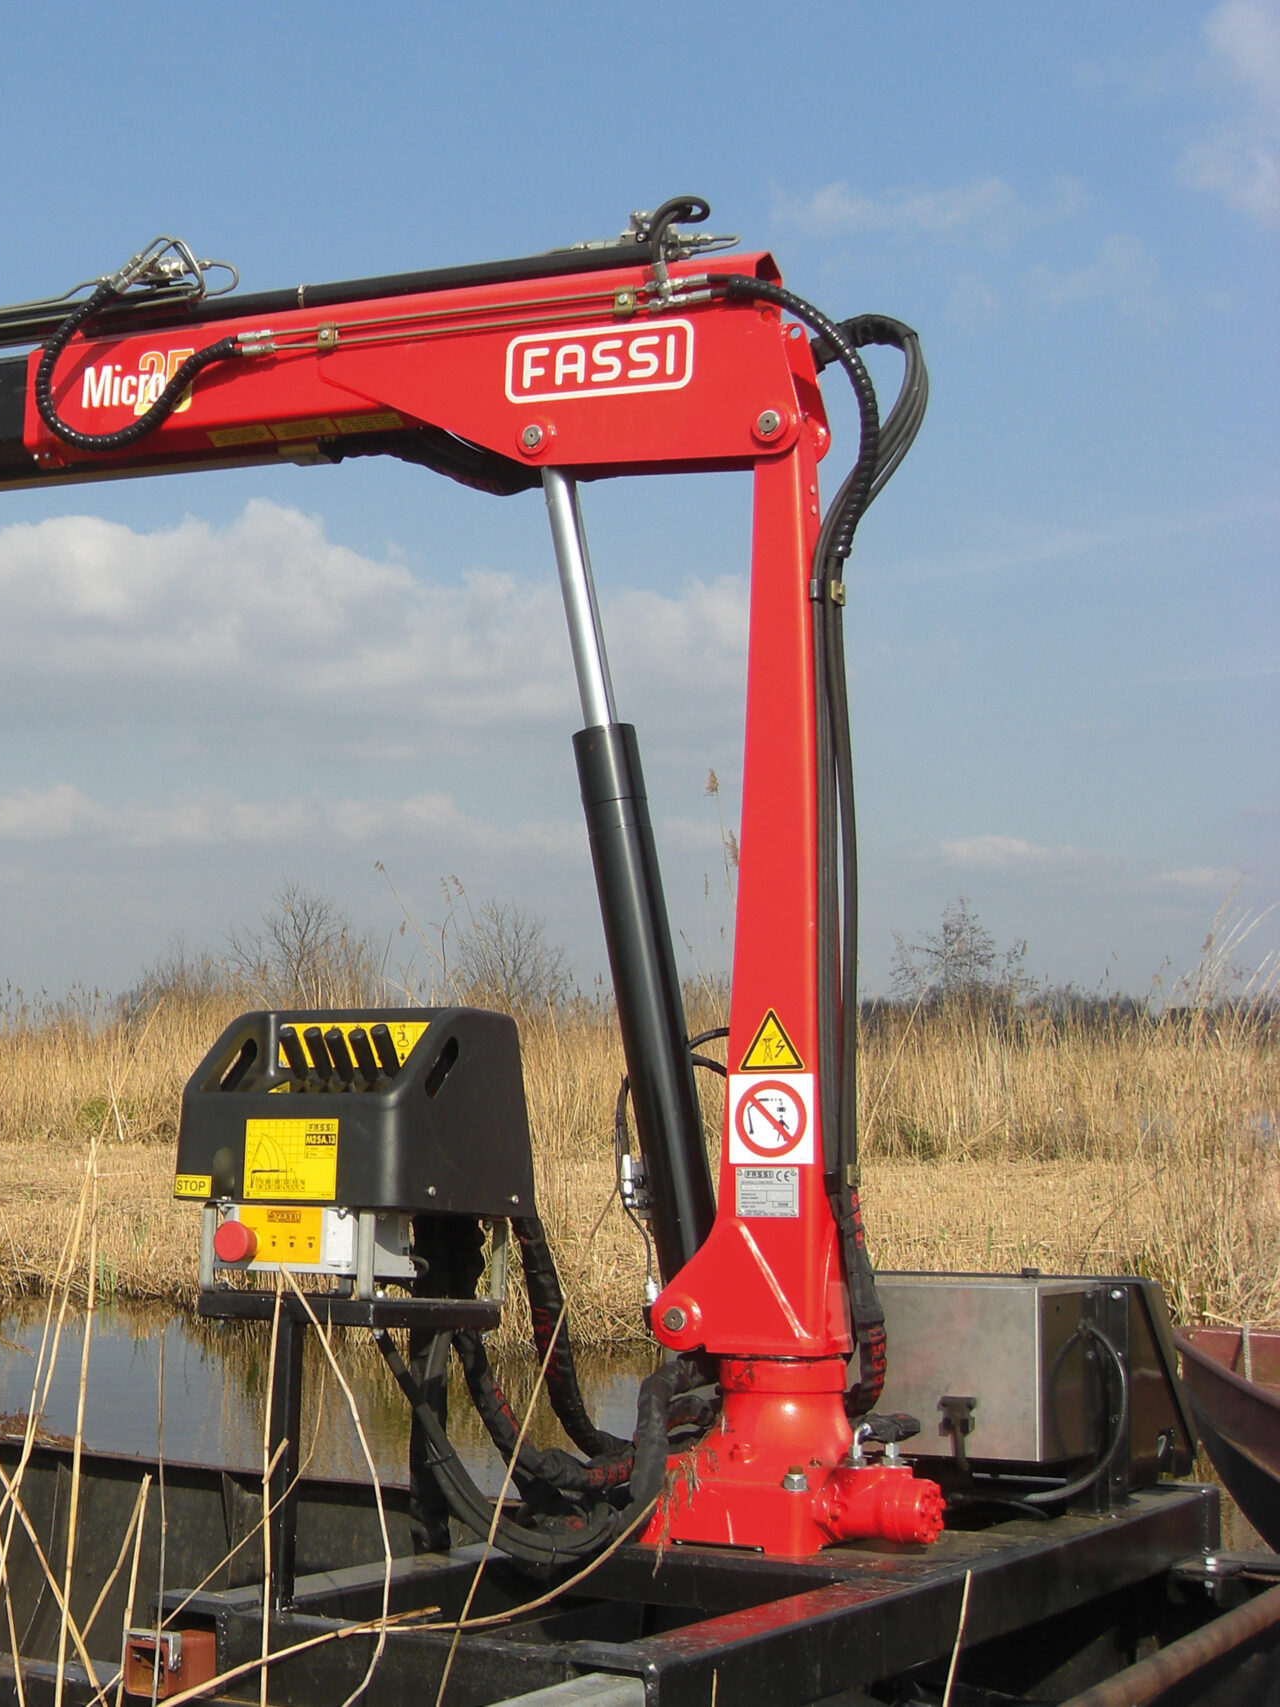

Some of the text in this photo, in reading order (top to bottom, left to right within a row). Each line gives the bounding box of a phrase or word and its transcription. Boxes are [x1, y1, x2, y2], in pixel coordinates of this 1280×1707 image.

[522, 334, 686, 389] FASSI
[82, 365, 166, 409] Micro
[308, 1123, 335, 1131] FASSI
[176, 1180, 206, 1191] STOP
